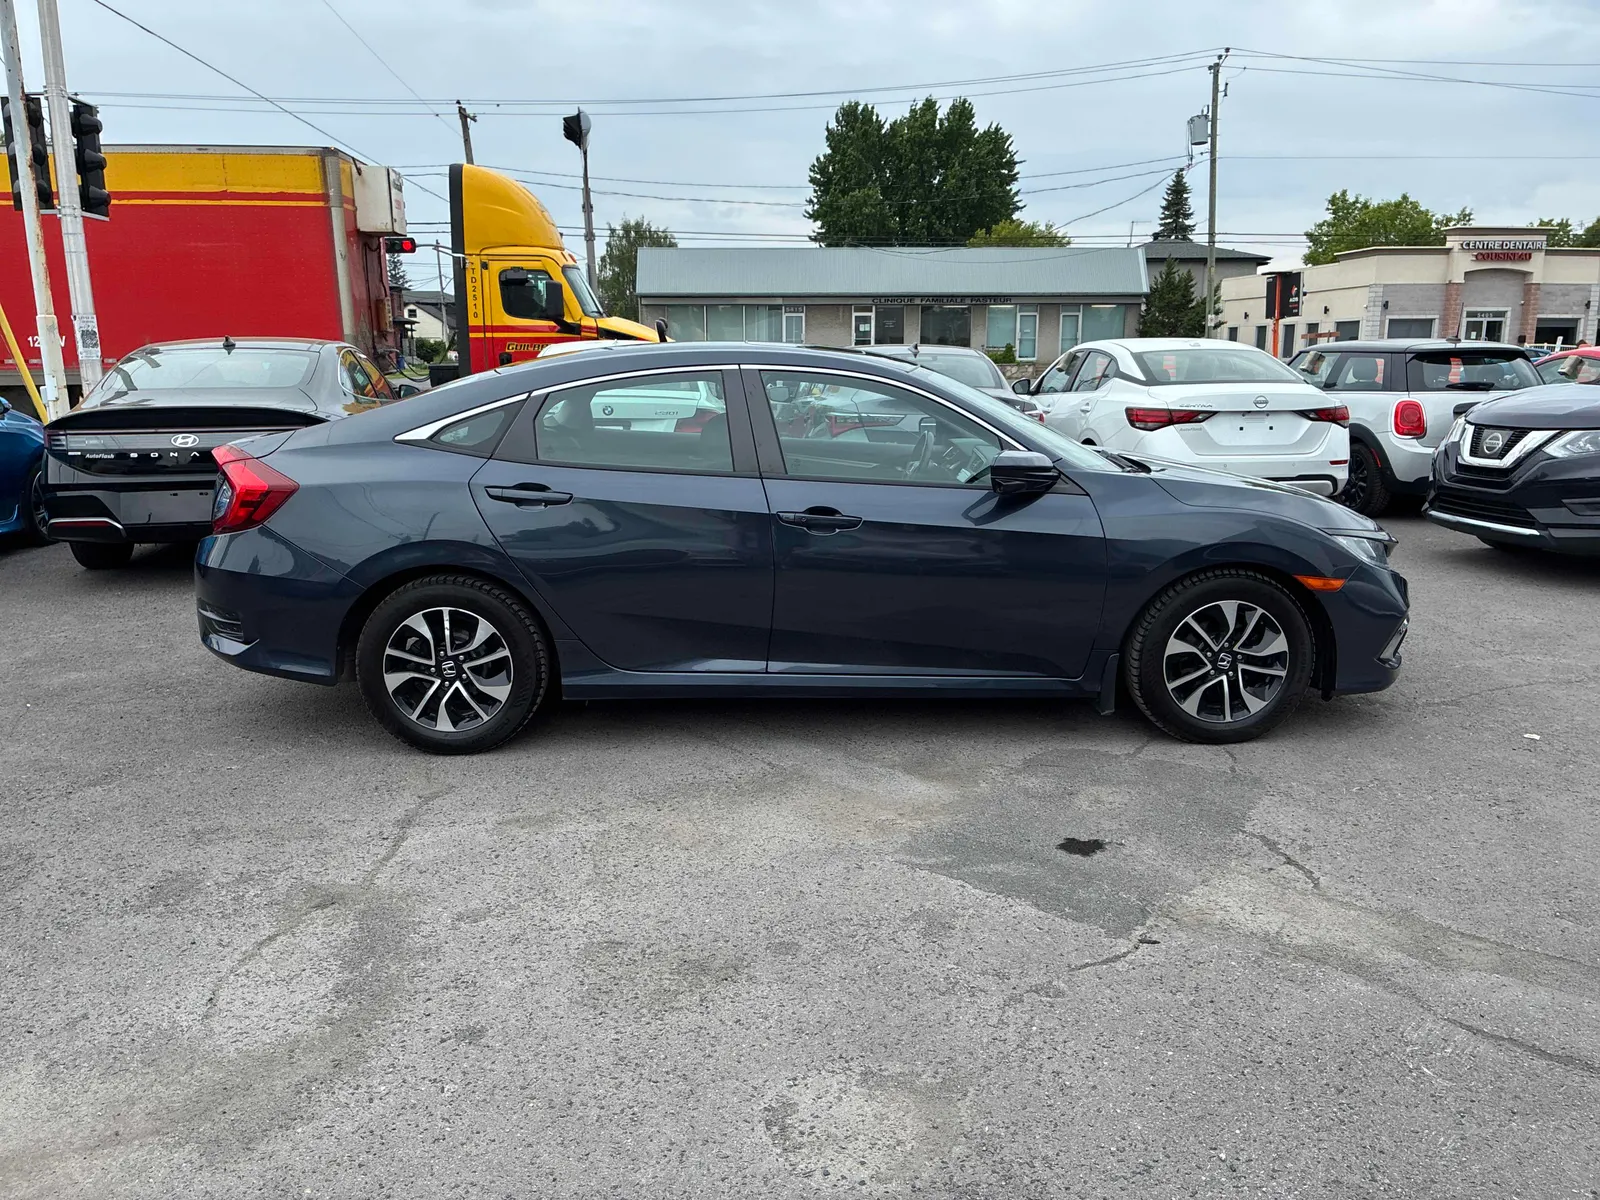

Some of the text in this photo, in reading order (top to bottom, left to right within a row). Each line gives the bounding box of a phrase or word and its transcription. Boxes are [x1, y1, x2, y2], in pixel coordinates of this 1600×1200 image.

[1462, 241, 1548, 250] CENTRE DENTAIRE
[1475, 252, 1532, 261] COUSINEAU
